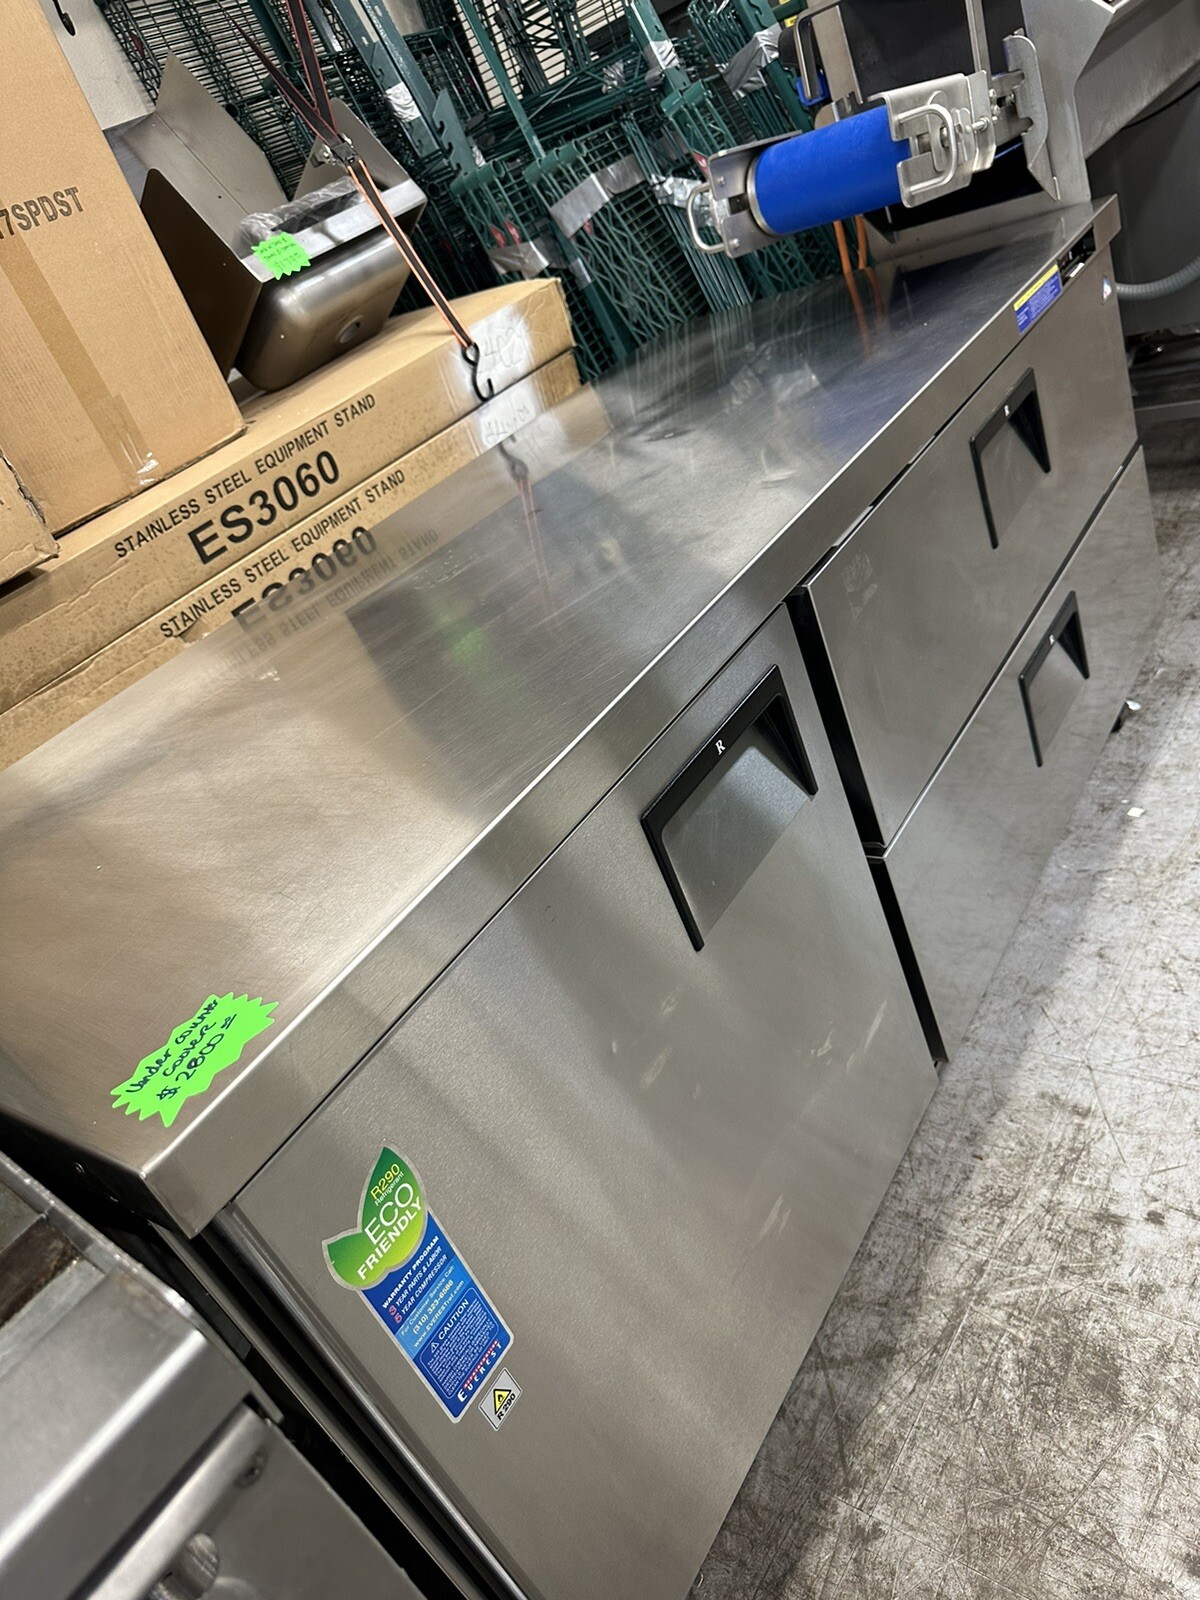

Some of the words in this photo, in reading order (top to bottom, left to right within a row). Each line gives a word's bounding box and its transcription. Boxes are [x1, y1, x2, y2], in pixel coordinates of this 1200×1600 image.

[0, 186, 84, 239] 7SPDST
[114, 498, 200, 557] STAINLESS
[204, 472, 252, 504] STEEL
[254, 420, 330, 474] EQUIPMENT
[334, 393, 376, 427] STAND
[188, 450, 340, 565] ES3060
[160, 578, 242, 638] STAINLESS
[244, 548, 290, 583] STEEL
[291, 498, 363, 552] EQUIPMENT
[364, 469, 406, 503] STAND
[715, 739, 726, 755] R
[370, 1163, 400, 1200] R290
[374, 1171, 405, 1206] Refrigerant
[357, 1196, 421, 1280] FRIENDLY
[364, 1183, 414, 1245] ECO
[381, 1269, 413, 1309] WARRANTY
[411, 1234, 439, 1270] PROGRAM
[388, 1303, 397, 1316] 3
[395, 1288, 409, 1306] YEAR
[407, 1270, 423, 1291] PARTS
[425, 1245, 442, 1267] LABOR
[401, 1295, 415, 1314] YEAR
[414, 1253, 447, 1298] COMPRESSOR
[408, 1297, 430, 1325] Customer
[429, 1276, 445, 1298] Service
[437, 1298, 469, 1340] CAUTION
[503, 1393, 516, 1412] 290
